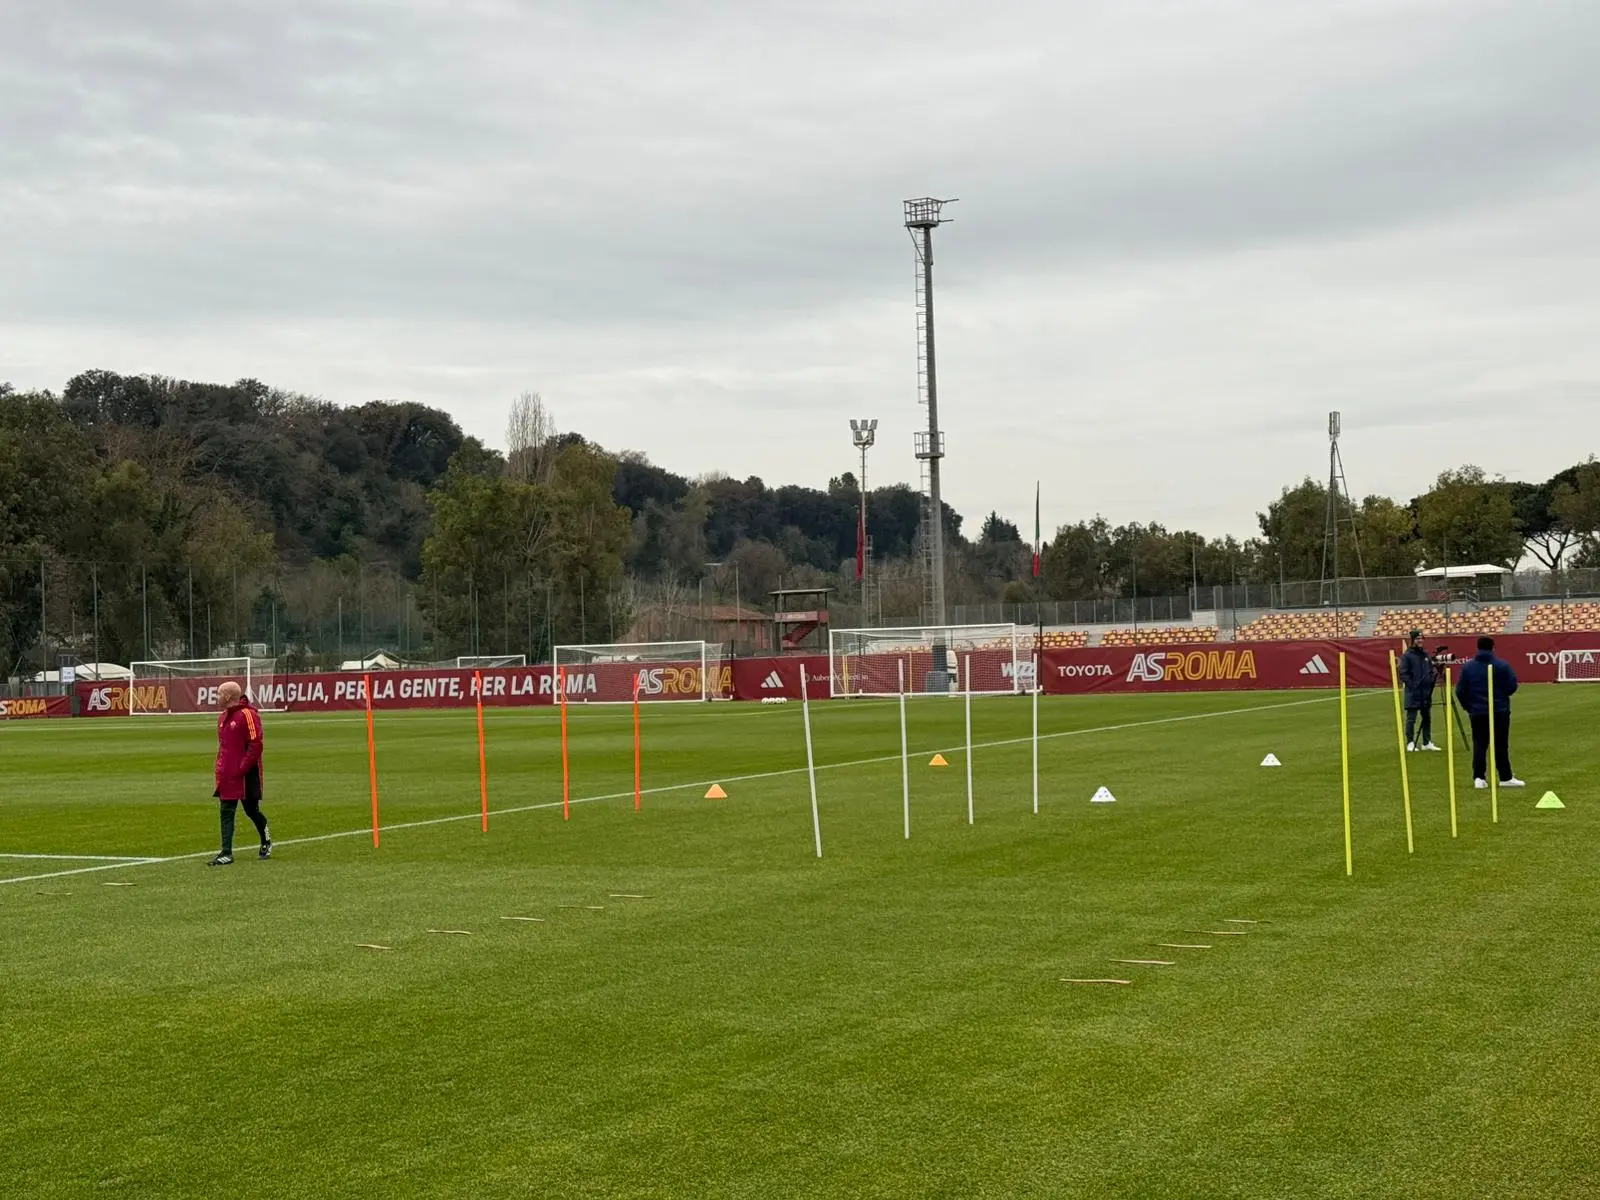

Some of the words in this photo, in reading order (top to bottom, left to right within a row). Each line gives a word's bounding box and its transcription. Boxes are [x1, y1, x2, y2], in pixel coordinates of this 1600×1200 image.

[1526, 652, 1595, 665] TOYOTA
[1058, 665, 1113, 677] TOYOTA
[197, 686, 220, 705] PE
[258, 682, 328, 703] MAGLIA,
[335, 680, 367, 699] PER
[373, 679, 395, 699] LA
[400, 677, 464, 699] GENTE,
[470, 676, 506, 696] PER
[511, 675, 534, 695] LA
[539, 673, 597, 694] ROMA
